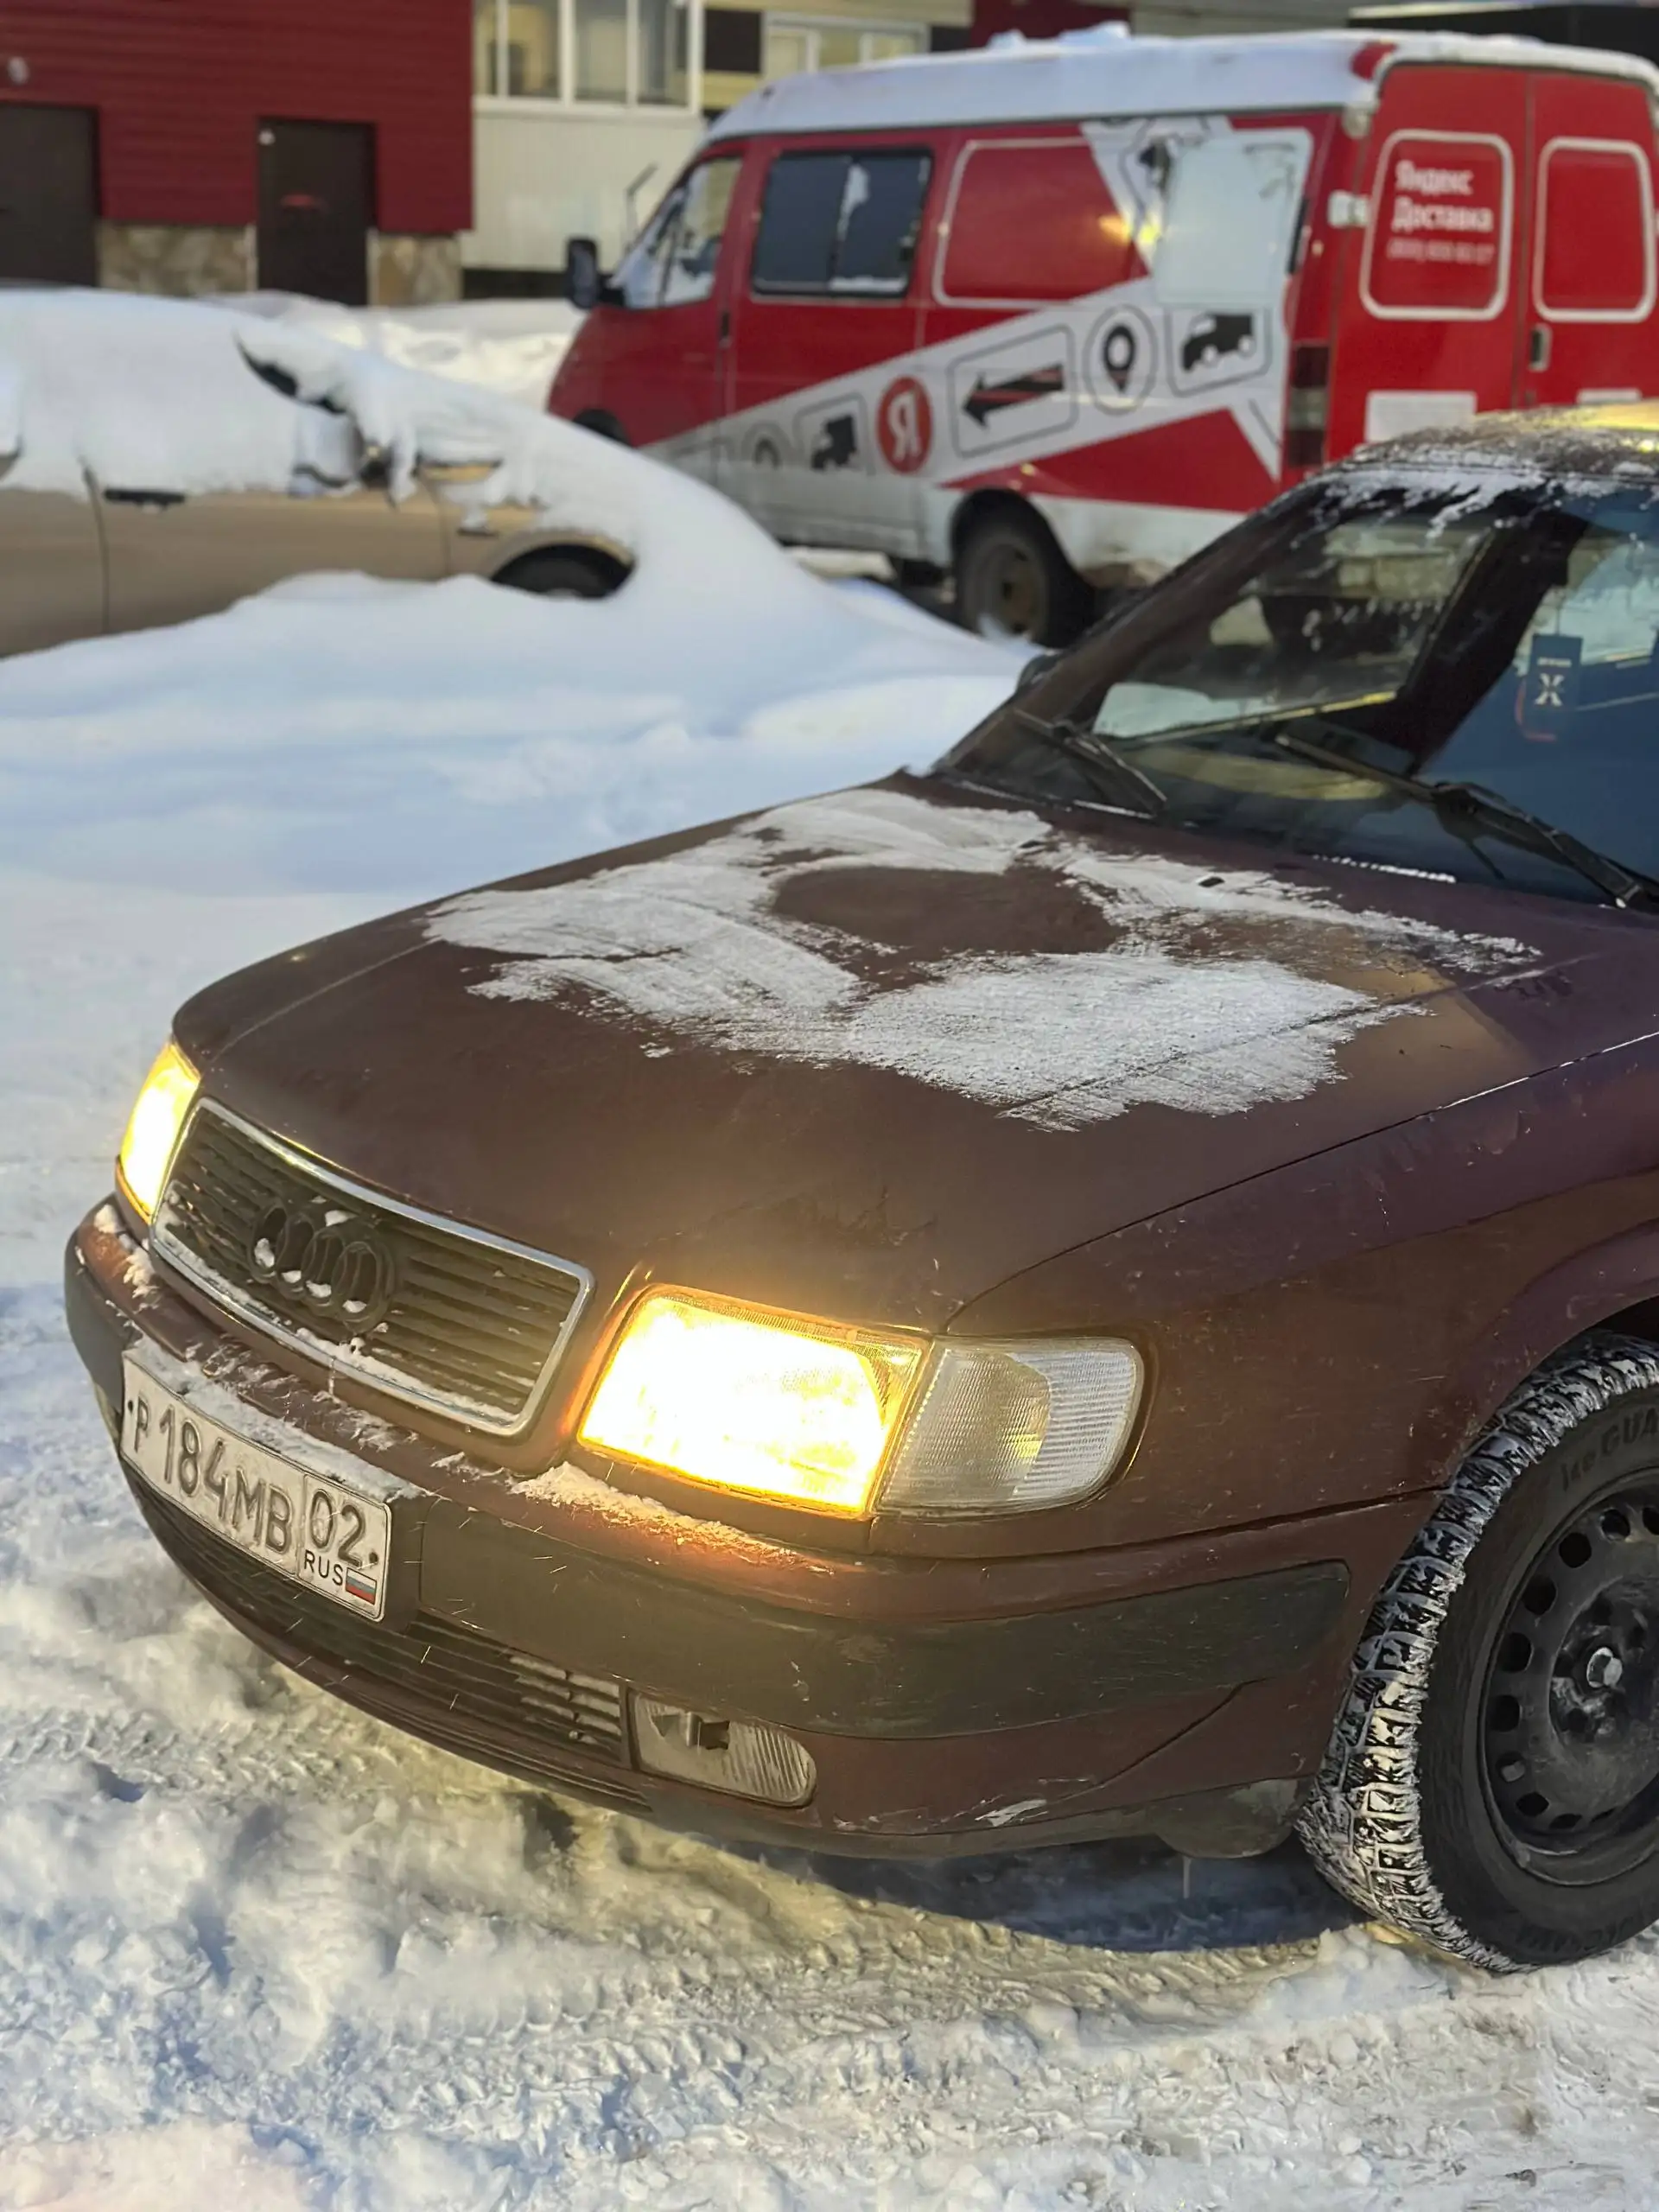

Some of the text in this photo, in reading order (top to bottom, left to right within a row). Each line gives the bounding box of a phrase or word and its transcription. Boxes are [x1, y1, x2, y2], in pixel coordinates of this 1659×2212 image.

[888, 391, 921, 461] Я
[309, 1488, 365, 1567] 02
[303, 1549, 344, 1586] RUS
